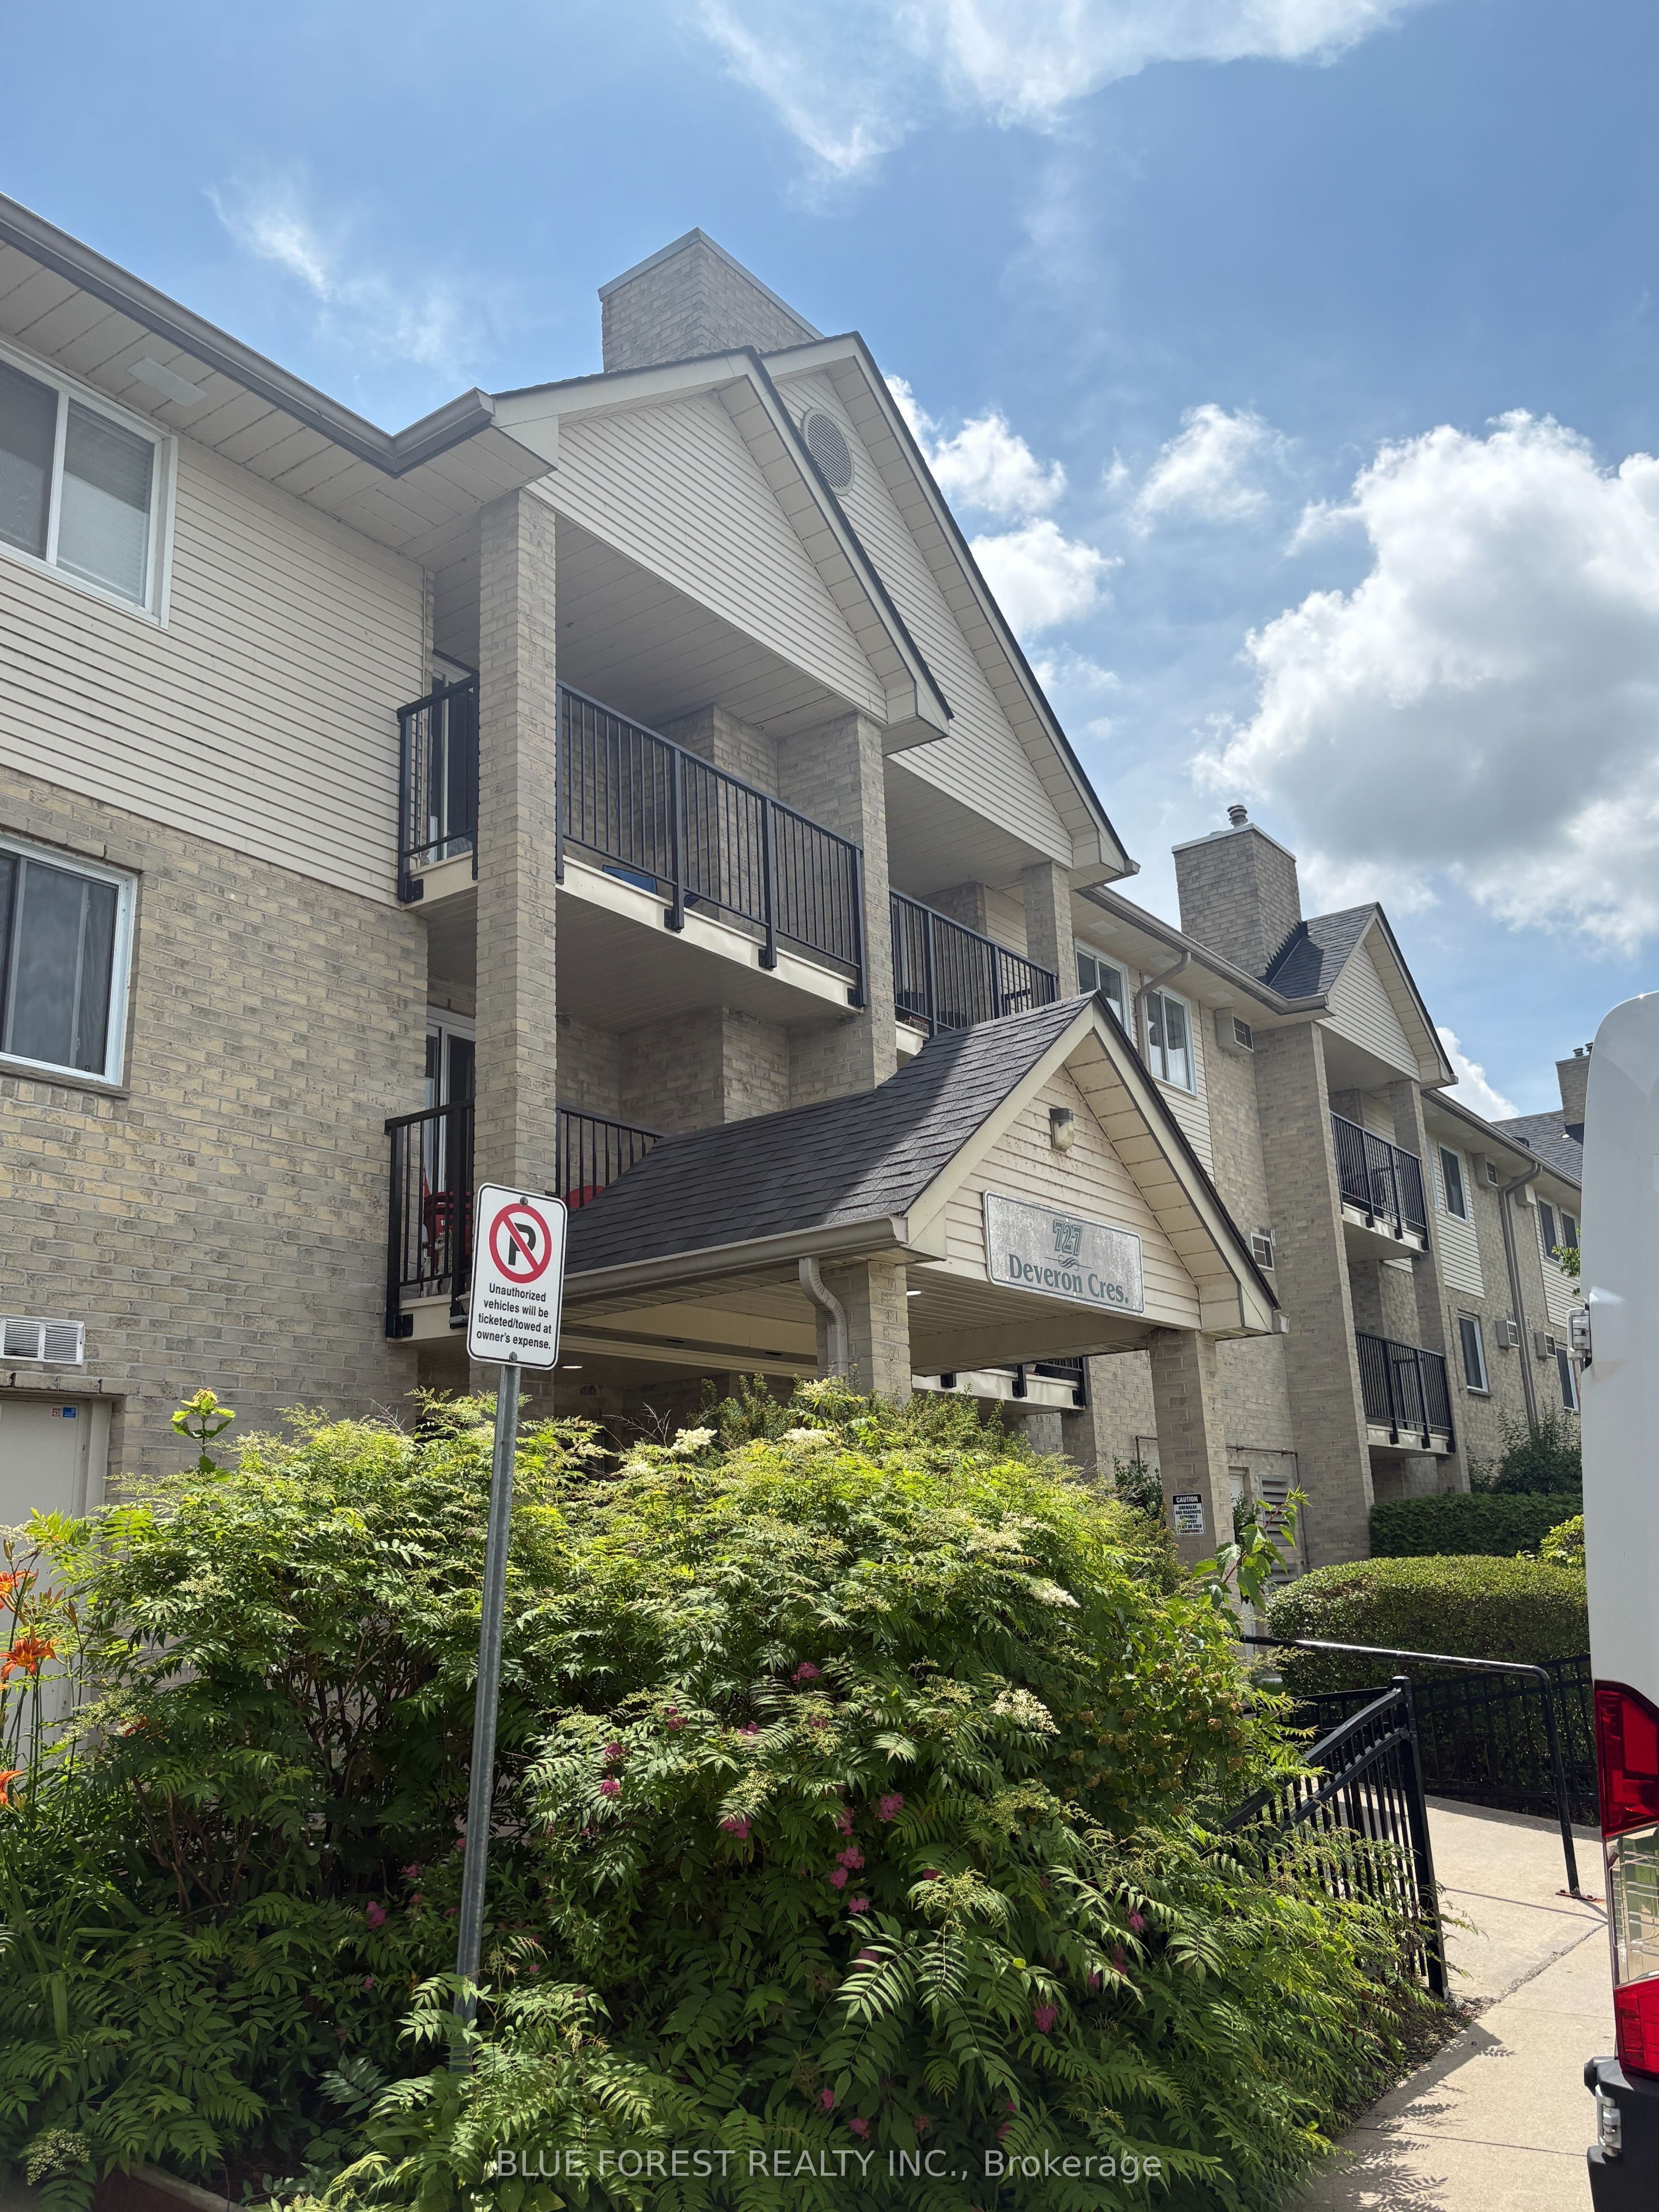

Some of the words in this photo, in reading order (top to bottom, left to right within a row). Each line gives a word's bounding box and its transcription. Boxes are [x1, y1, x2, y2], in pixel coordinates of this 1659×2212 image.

[1052, 1219, 1083, 1256] 727
[1009, 1254, 1083, 1293] Deveron
[1088, 1274, 1129, 1304] Cres.
[489, 1283, 546, 1302] Unauthorized
[483, 1300, 519, 1313] vehicles
[522, 1304, 536, 1316] will
[538, 1308, 548, 1318] be
[478, 1313, 540, 1332] ticketed/towed
[543, 1324, 551, 1334] at
[476, 1330, 510, 1343] owner's
[513, 1336, 551, 1350] expense.
